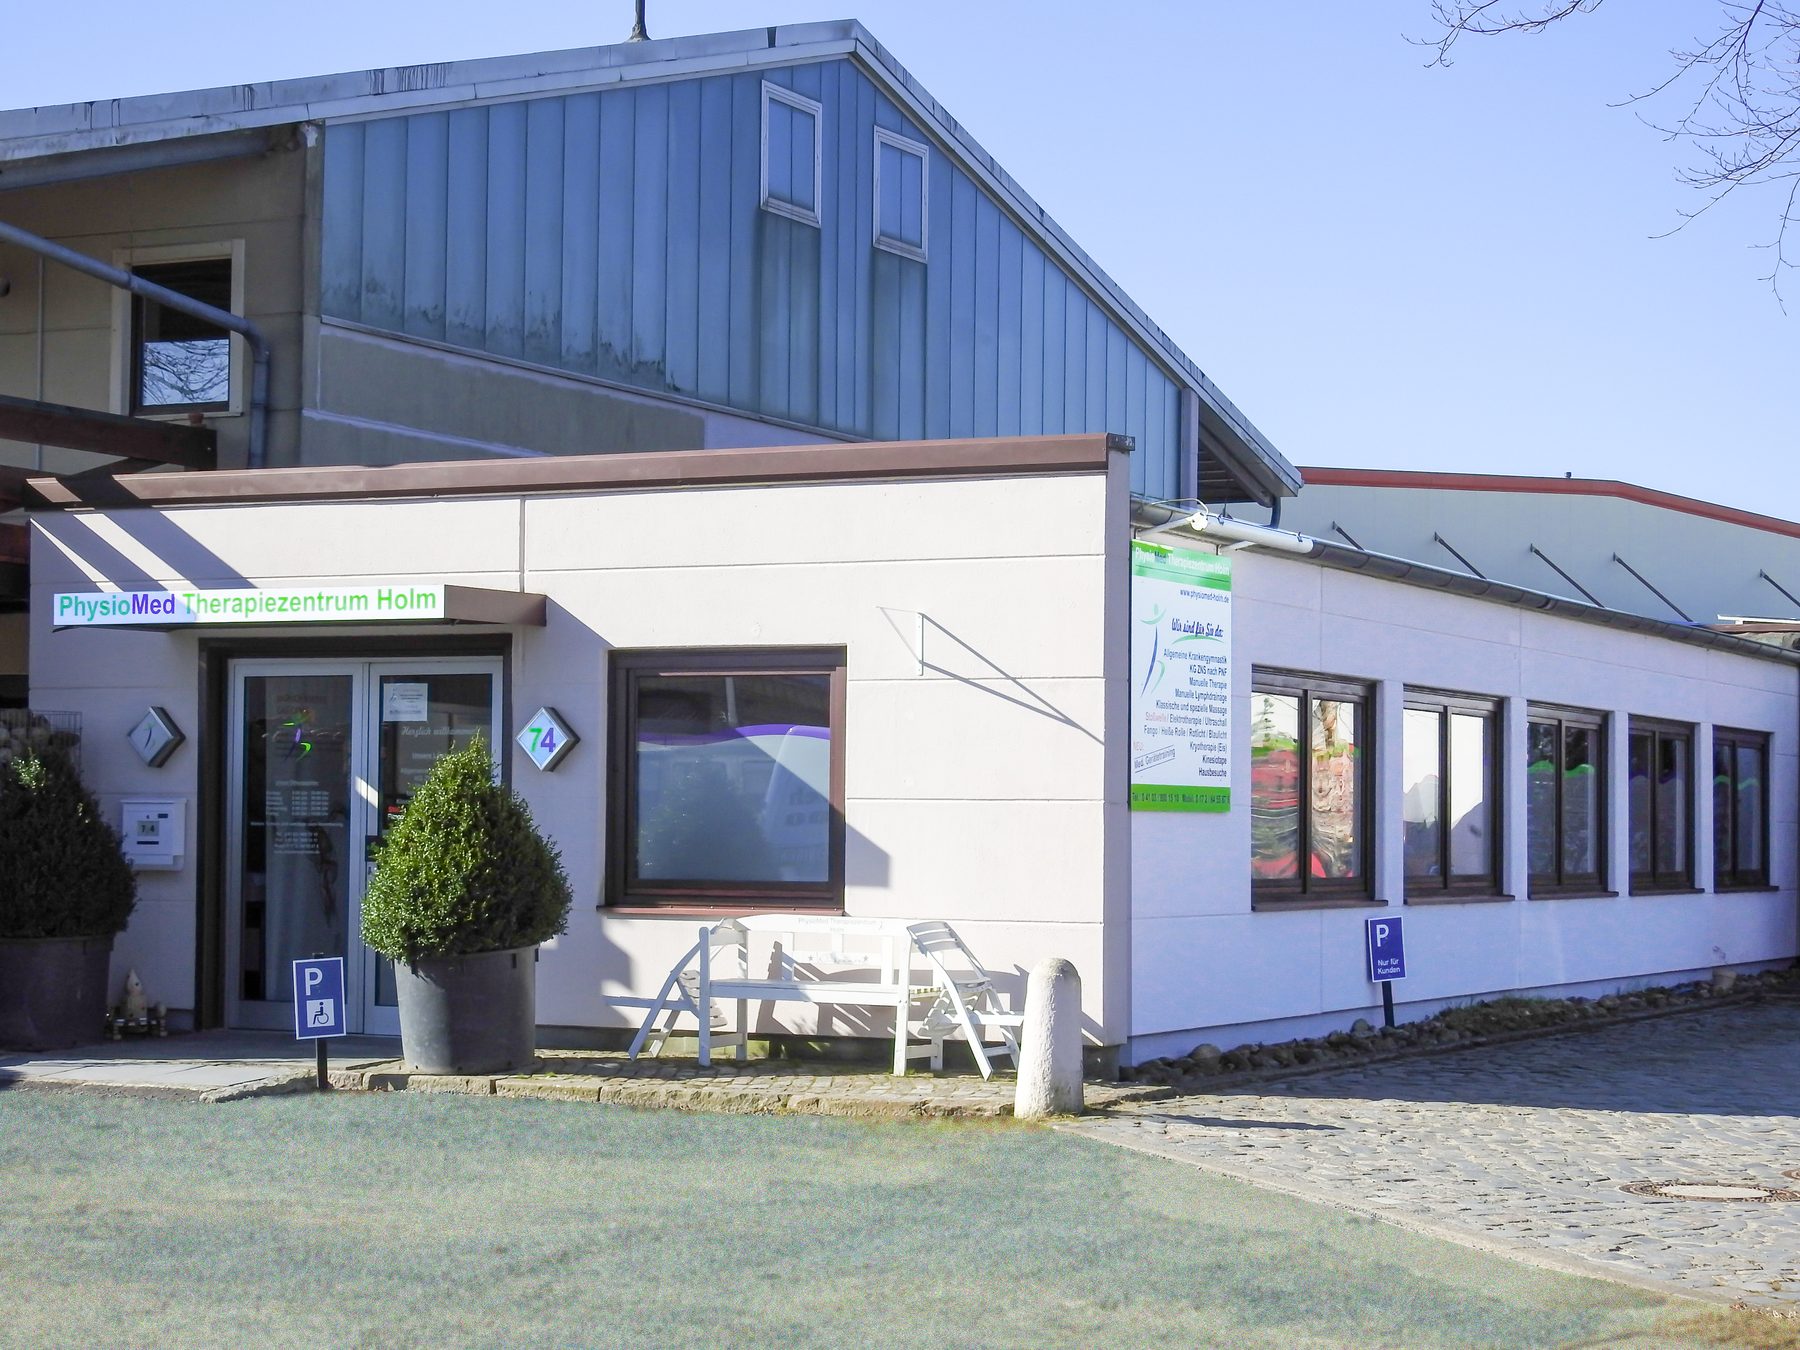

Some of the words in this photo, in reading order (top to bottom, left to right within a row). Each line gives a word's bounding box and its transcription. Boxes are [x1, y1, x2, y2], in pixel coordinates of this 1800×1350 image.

[59, 593, 175, 621] PhysioMed
[182, 591, 368, 618] Therapiezentrum
[377, 588, 436, 610] Holm
[1171, 618, 1182, 632] Wir
[1183, 620, 1194, 634] sind
[1163, 648, 1188, 661] Allgemeine
[1188, 651, 1227, 664] Krankengymnastik
[1189, 664, 1197, 674] KG
[1197, 665, 1207, 675] ZNS
[1207, 666, 1217, 675] nach
[1218, 667, 1227, 677] PNF
[1189, 677, 1208, 688] Manuelle
[1209, 679, 1227, 690] Therapie
[1175, 688, 1194, 699] Manuelle
[1195, 690, 1227, 704] Lymphdrainage
[1156, 700, 1180, 710] Klassische
[1180, 702, 1189, 711] und
[1190, 703, 1208, 714] spezielle
[1209, 705, 1227, 716] Massage
[1169, 714, 1202, 726] Elektrotherapie
[1205, 716, 1227, 727] Ultraschall
[528, 727, 556, 753] 74
[1144, 725, 1158, 737] Fango
[1189, 728, 1206, 739] Rotlicht
[1209, 730, 1227, 740] Blaulicht
[1190, 741, 1217, 752] Kryotherapie
[1202, 755, 1227, 765] Kinesiotape
[1198, 767, 1227, 778] Hausbesuche
[1376, 924, 1389, 947] P
[1377, 967, 1400, 975] Kunden
[304, 967, 323, 996] P
